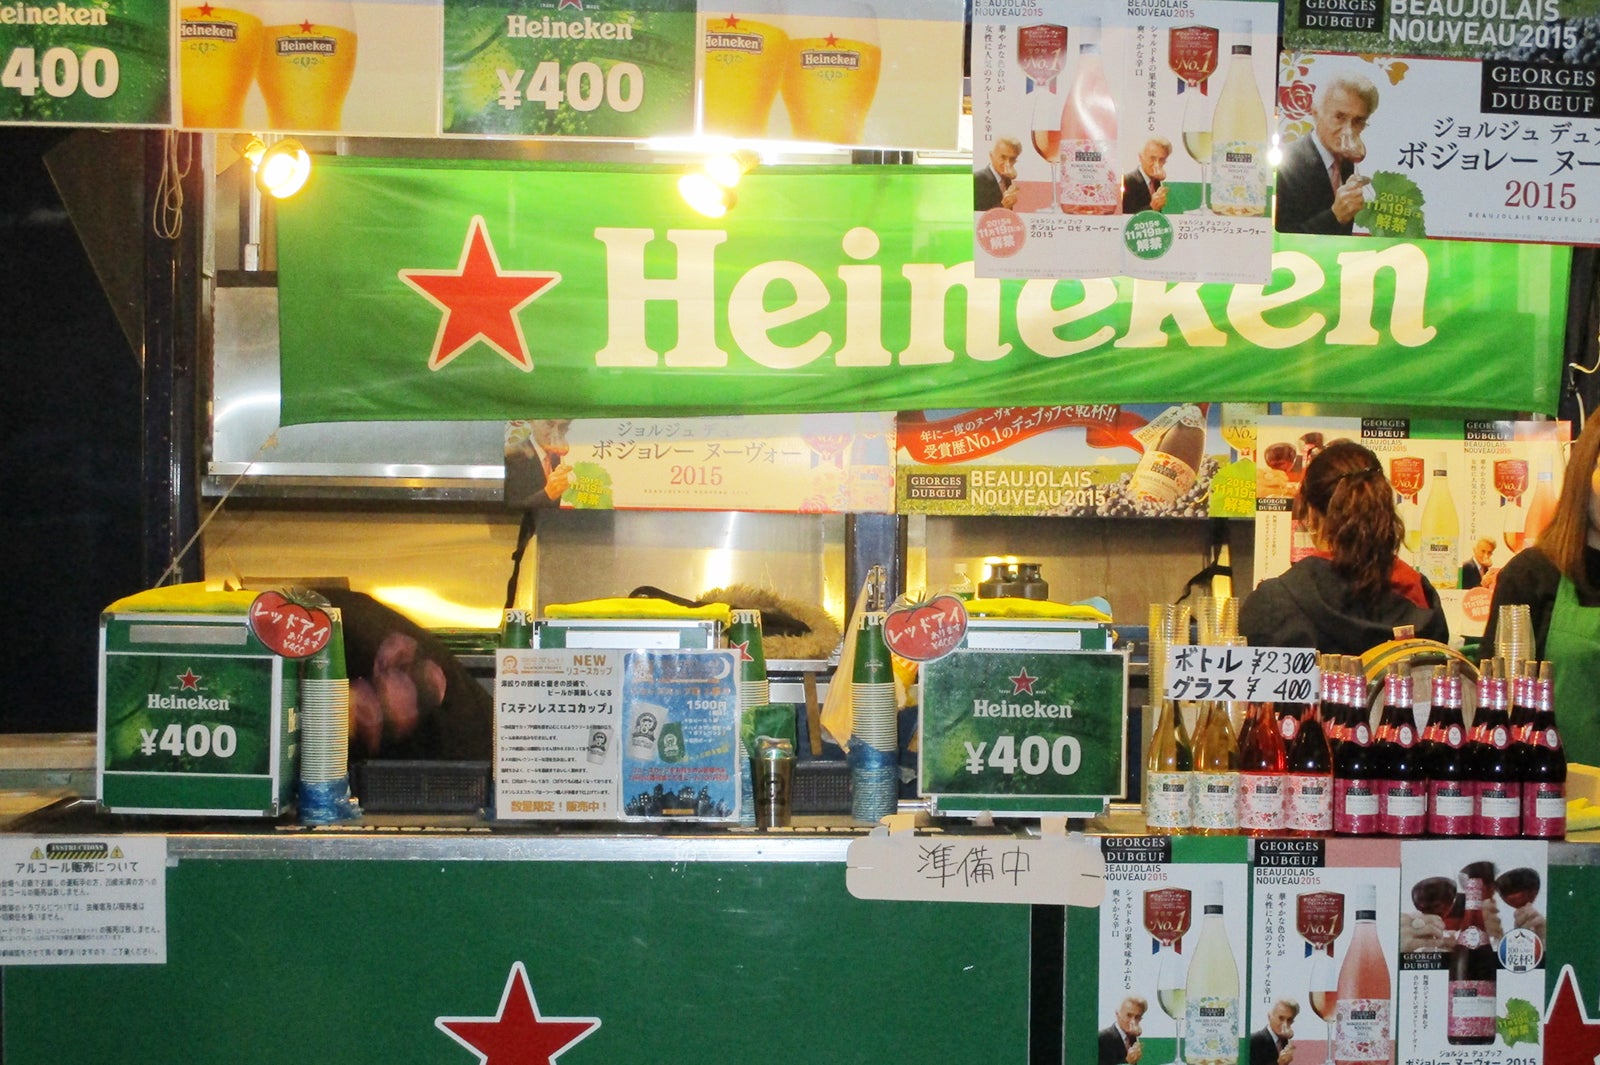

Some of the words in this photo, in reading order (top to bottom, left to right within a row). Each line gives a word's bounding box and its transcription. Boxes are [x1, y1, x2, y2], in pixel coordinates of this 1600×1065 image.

[0, 2, 108, 26] eineken
[1307, 0, 1376, 11] GEORGES
[1391, 0, 1559, 21] BEAUJOLAIS
[506, 15, 634, 40] Heineken
[280, 40, 334, 51] Heineken
[1135, 24, 1145, 77] 爽やかな辛口
[805, 54, 857, 65] Heineken
[496, 61, 645, 113] ¥400
[1492, 66, 1596, 87] GEORGES
[1492, 93, 1594, 113] DUBŒUF
[1434, 117, 1540, 141] ジョルジュ
[1398, 142, 1538, 172] ボジョレー
[1504, 180, 1578, 210] 2015
[1375, 214, 1408, 233] 解禁
[593, 227, 1438, 370] Heineken
[618, 421, 695, 438] ジョルジュ
[1363, 419, 1406, 428] GEORGES
[592, 439, 694, 461] ボジョレー
[703, 441, 802, 464] ヌーヴォー
[670, 465, 723, 486] 2015
[911, 476, 962, 486] GEORGES
[970, 470, 1093, 488] BEAUJOLAIS
[254, 602, 329, 642] レッドアイ
[888, 606, 960, 644] レッドアイ
[283, 639, 305, 656] ¥400
[573, 655, 606, 666] NEW
[1175, 647, 1243, 673] ボトル
[547, 689, 613, 697] ビールが美味しくなる
[1172, 676, 1236, 699] グラス
[147, 694, 230, 711] Heineken
[501, 702, 613, 714] 「ステンレスエコカップ」
[973, 700, 1073, 719] Heineken
[140, 724, 237, 758] ¥400
[964, 735, 1082, 776] ¥400
[1106, 837, 1165, 848] GEORGES
[1260, 842, 1319, 851] GEORGES
[917, 843, 1030, 888] 準備中
[1107, 852, 1165, 861] DUBŒUF
[1260, 856, 1318, 865] DUBŒUF
[15, 862, 139, 873] アルコール販売について
[1256, 877, 1299, 885] NOUVEAU
[1301, 877, 1320, 885] 2015
[1112, 889, 1120, 938] 爽やかな辛口
[1151, 910, 1186, 932] No.1
[1277, 892, 1286, 956] 華やかな色合いが
[1305, 914, 1339, 935] No.1
[1124, 889, 1133, 990] シャルドネの果実味あふれる
[1264, 892, 1274, 1003] 女性に人気のフルーティな辛口
